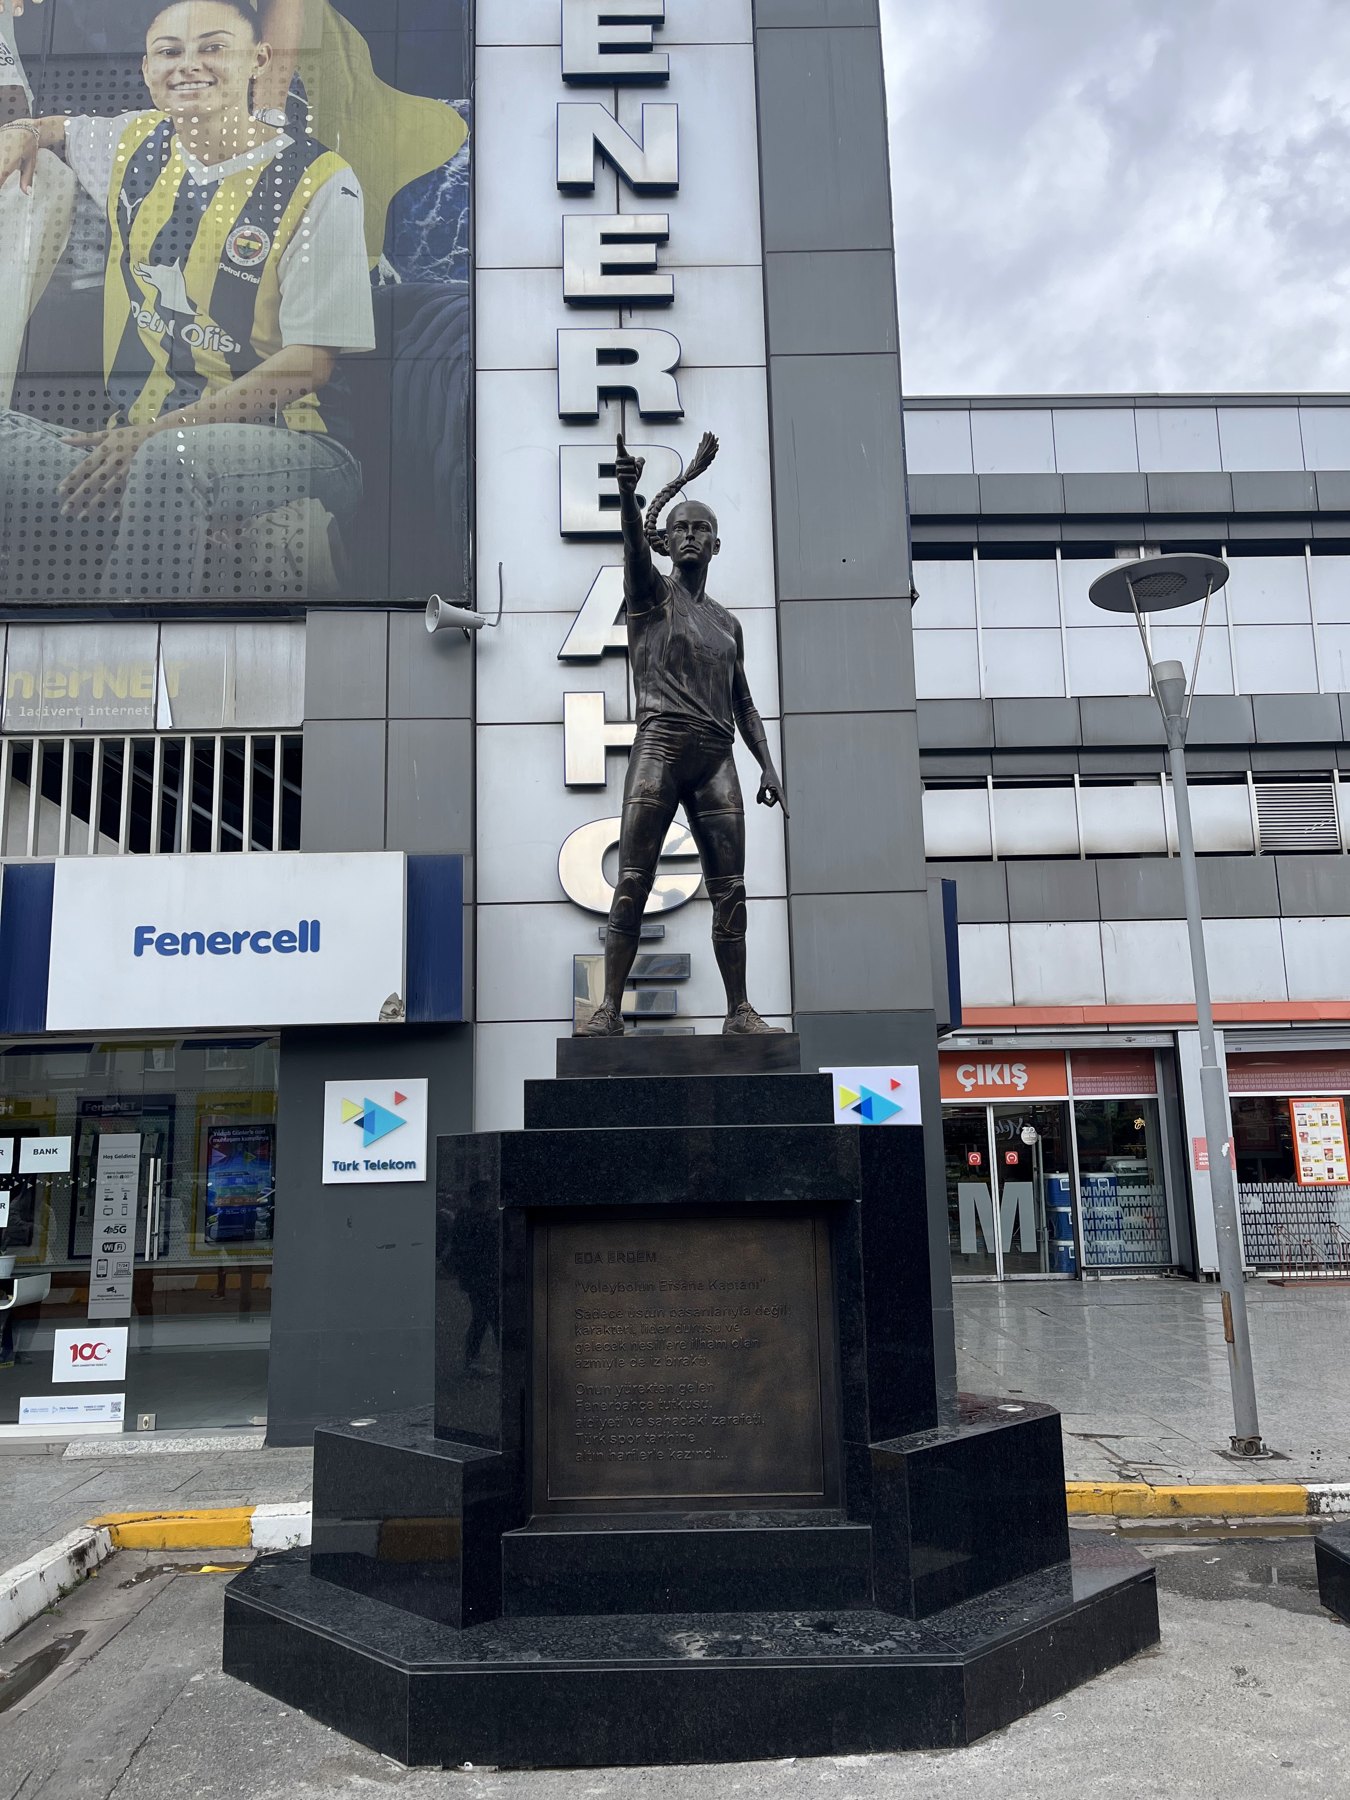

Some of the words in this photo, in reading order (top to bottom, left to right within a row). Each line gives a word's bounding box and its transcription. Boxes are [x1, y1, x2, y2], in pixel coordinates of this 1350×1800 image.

[219, 263, 240, 277] Petrol
[241, 272, 261, 284] Ofisi
[20, 706, 81, 717] lacivert
[88, 705, 149, 716] internet
[133, 920, 320, 957] Fenercell
[956, 1063, 1029, 1092] ÇIKIŞ
[332, 1160, 359, 1171] Türk
[363, 1159, 416, 1170] Telekom
[575, 1252, 603, 1264] EDA
[608, 1250, 656, 1263] ERDEM
[660, 1280, 704, 1291] Efsane
[575, 1308, 623, 1319] Sadece
[725, 1323, 741, 1332] ve
[575, 1339, 626, 1355] gelecek
[729, 1337, 760, 1349] olan
[575, 1356, 626, 1370] azmiyle
[630, 1355, 646, 1367] de
[650, 1355, 661, 1367] iz
[575, 1383, 611, 1395] Onun
[615, 1382, 673, 1397] yürekten
[678, 1381, 715, 1396] gelen
[575, 1399, 654, 1413] Fenerbahçe
[627, 1417, 644, 1426] ve
[647, 1414, 708, 1427] sahadaki
[575, 1433, 605, 1445] Türk
[609, 1434, 641, 1446] spor
[644, 1431, 696, 1445] tarihine
[575, 1450, 604, 1462] altın
[608, 1448, 664, 1461] harflerle
